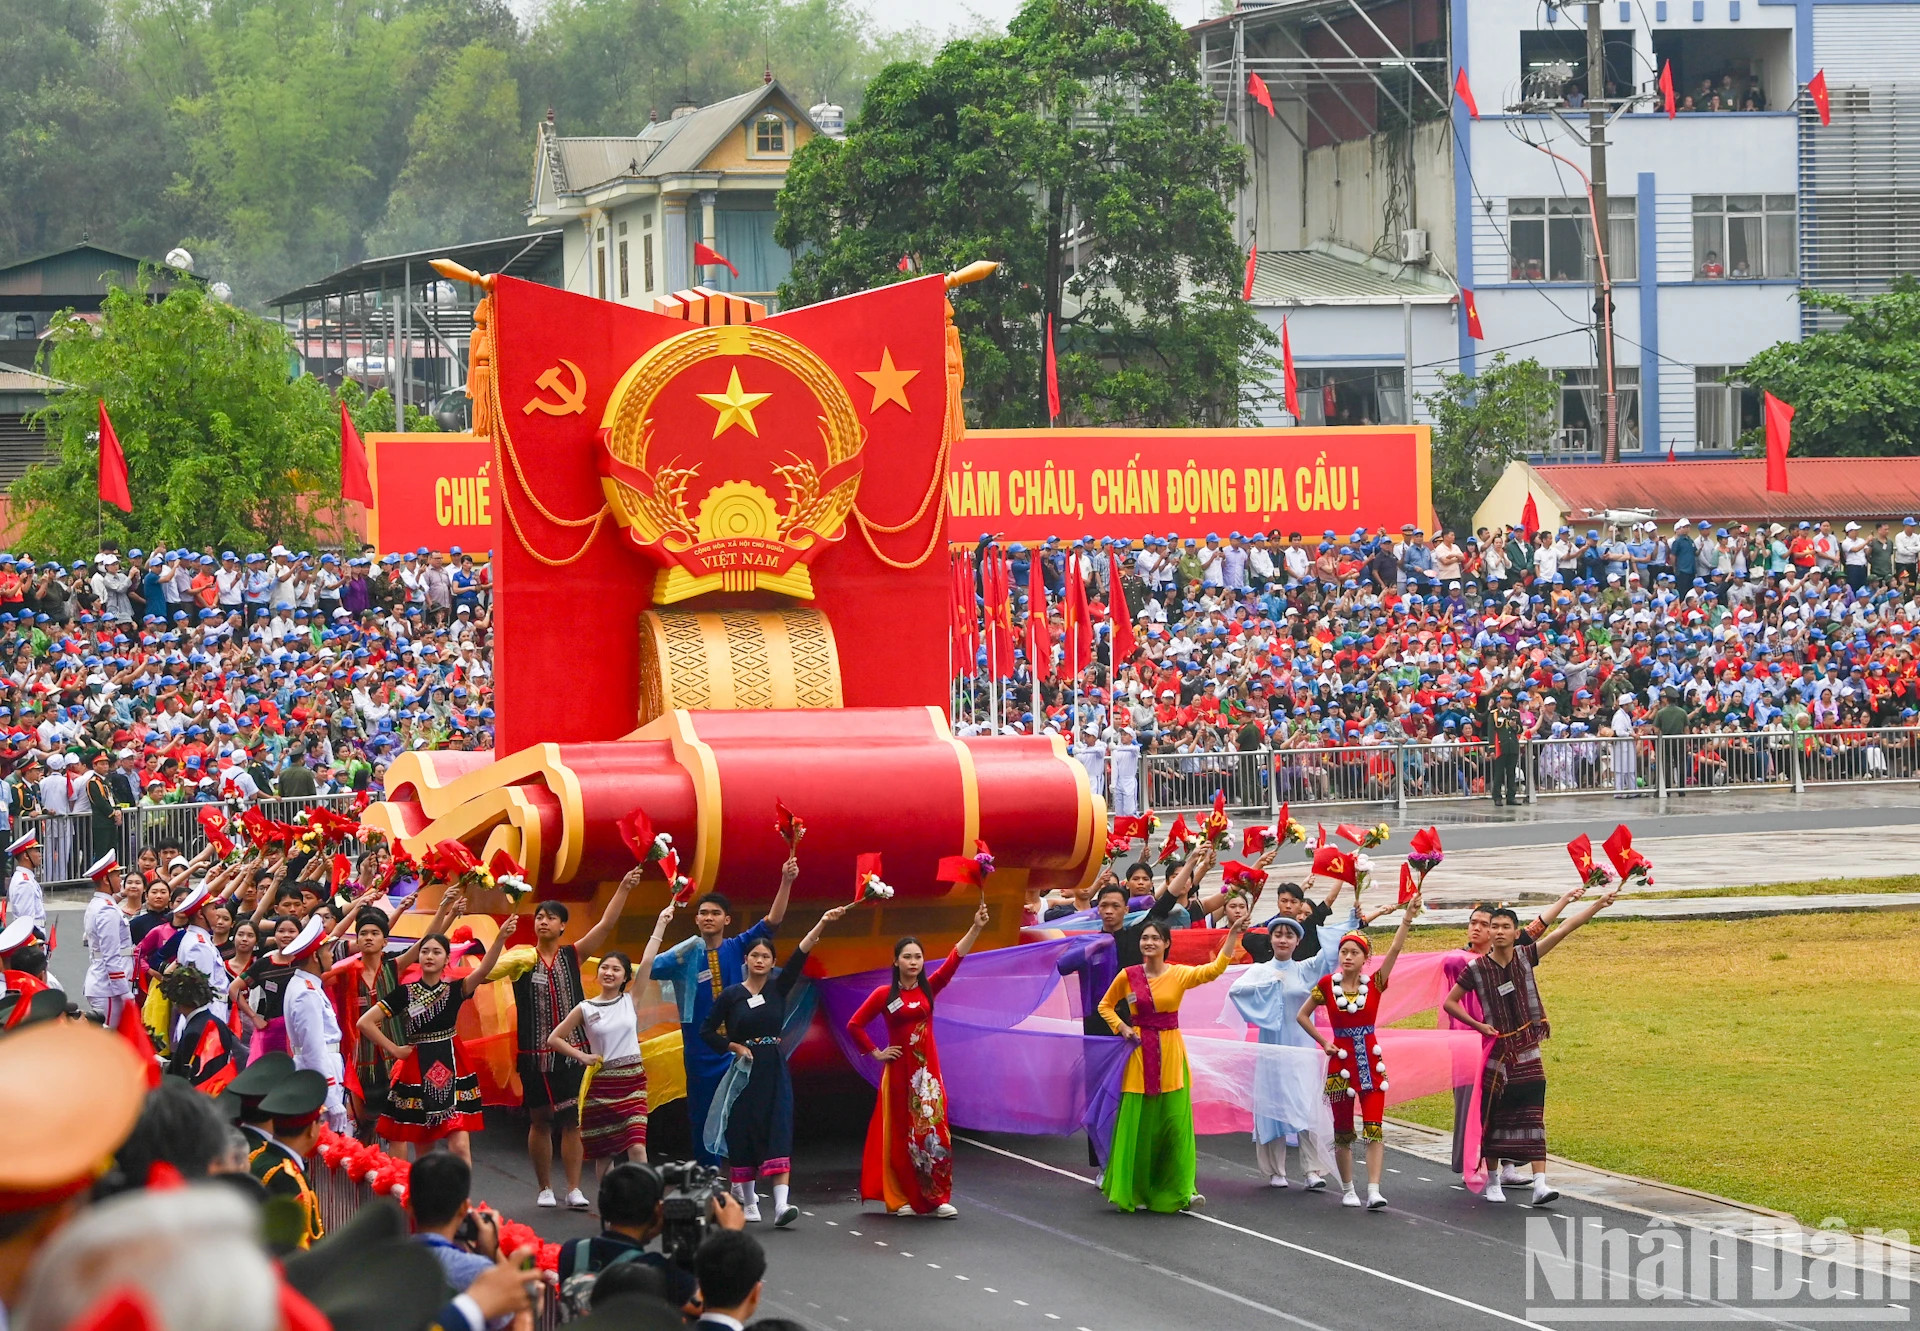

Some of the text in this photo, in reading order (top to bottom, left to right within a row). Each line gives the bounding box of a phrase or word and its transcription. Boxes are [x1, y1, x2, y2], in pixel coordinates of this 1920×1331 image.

[435, 461, 492, 527] CHIẾ
[947, 461, 1000, 517] NĂM
[1008, 460, 1084, 520] CHÂU,
[1091, 453, 1160, 515] CHẤN
[1166, 459, 1237, 524] ĐỘNG
[1244, 467, 1288, 523] ĐỊA
[694, 546, 711, 555] CỘNG
[712, 542, 725, 550] HÒA
[727, 540, 737, 548] XÃ
[739, 540, 750, 548] HỘI
[766, 544, 785, 553] NGHĨA
[700, 550, 779, 569] VIỆT NAM
